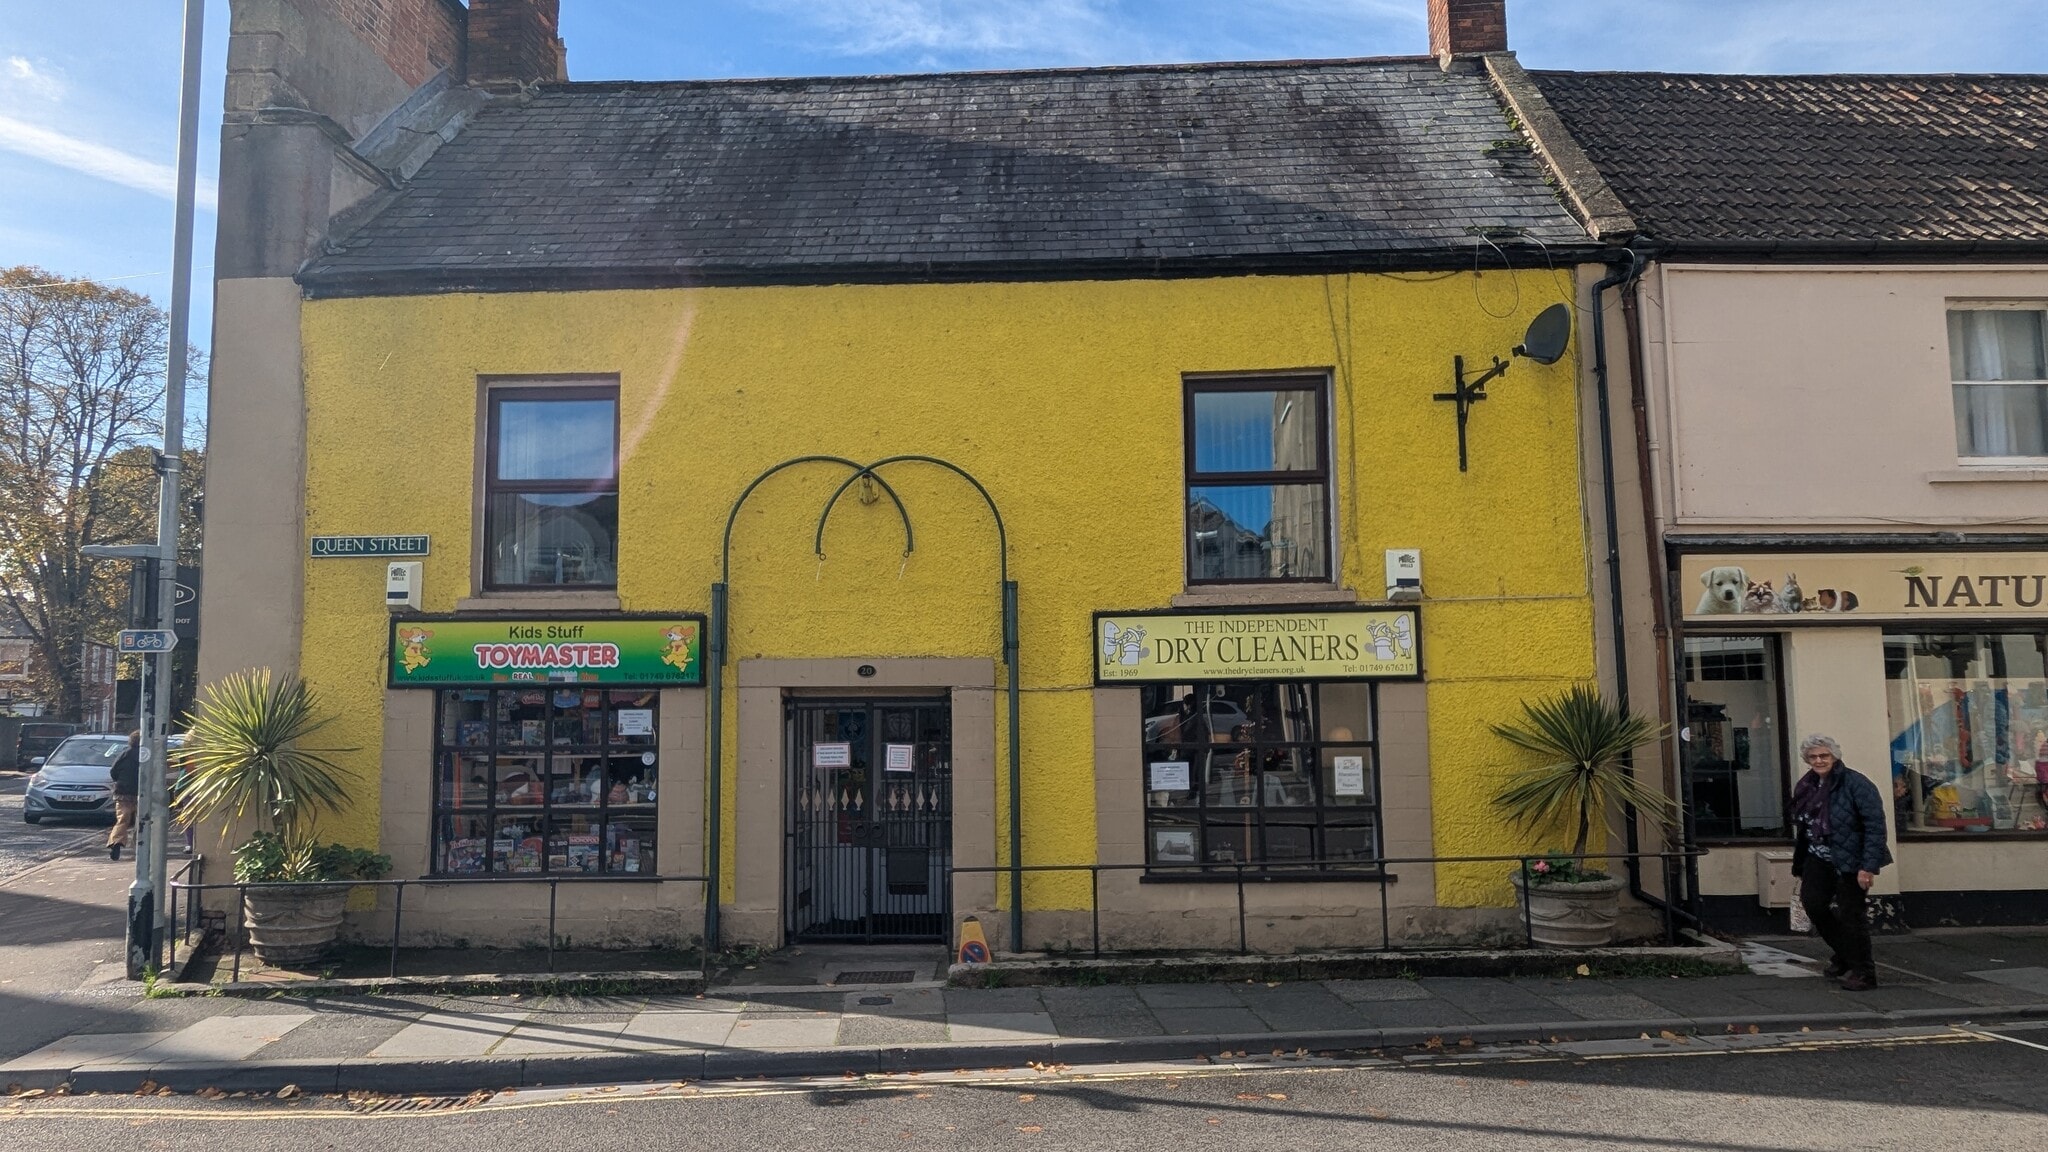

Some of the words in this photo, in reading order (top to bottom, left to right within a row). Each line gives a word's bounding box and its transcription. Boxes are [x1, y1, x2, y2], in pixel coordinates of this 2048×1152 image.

[316, 539, 364, 554] QUEEN
[369, 537, 425, 551] STREET
[1904, 575, 2048, 608] NATU
[509, 625, 543, 639] Kids
[547, 625, 585, 638] Stuff
[1184, 620, 1214, 634] THE
[1219, 618, 1328, 634] INDEPENDENT
[475, 643, 619, 668] TOYMASTER
[1154, 637, 1210, 665] DRY
[1217, 634, 1360, 663] CLEANERS
[861, 667, 872, 675] 20
[1103, 669, 1117, 677] Est:
[1120, 669, 1139, 677] 1969
[1203, 666, 1306, 676] www.thedrycleaners.org.uk
[1343, 664, 1357, 673] Tel:
[1359, 664, 1383, 672] 01749
[1385, 663, 1414, 671] 676217
[513, 672, 533, 681] REAL
